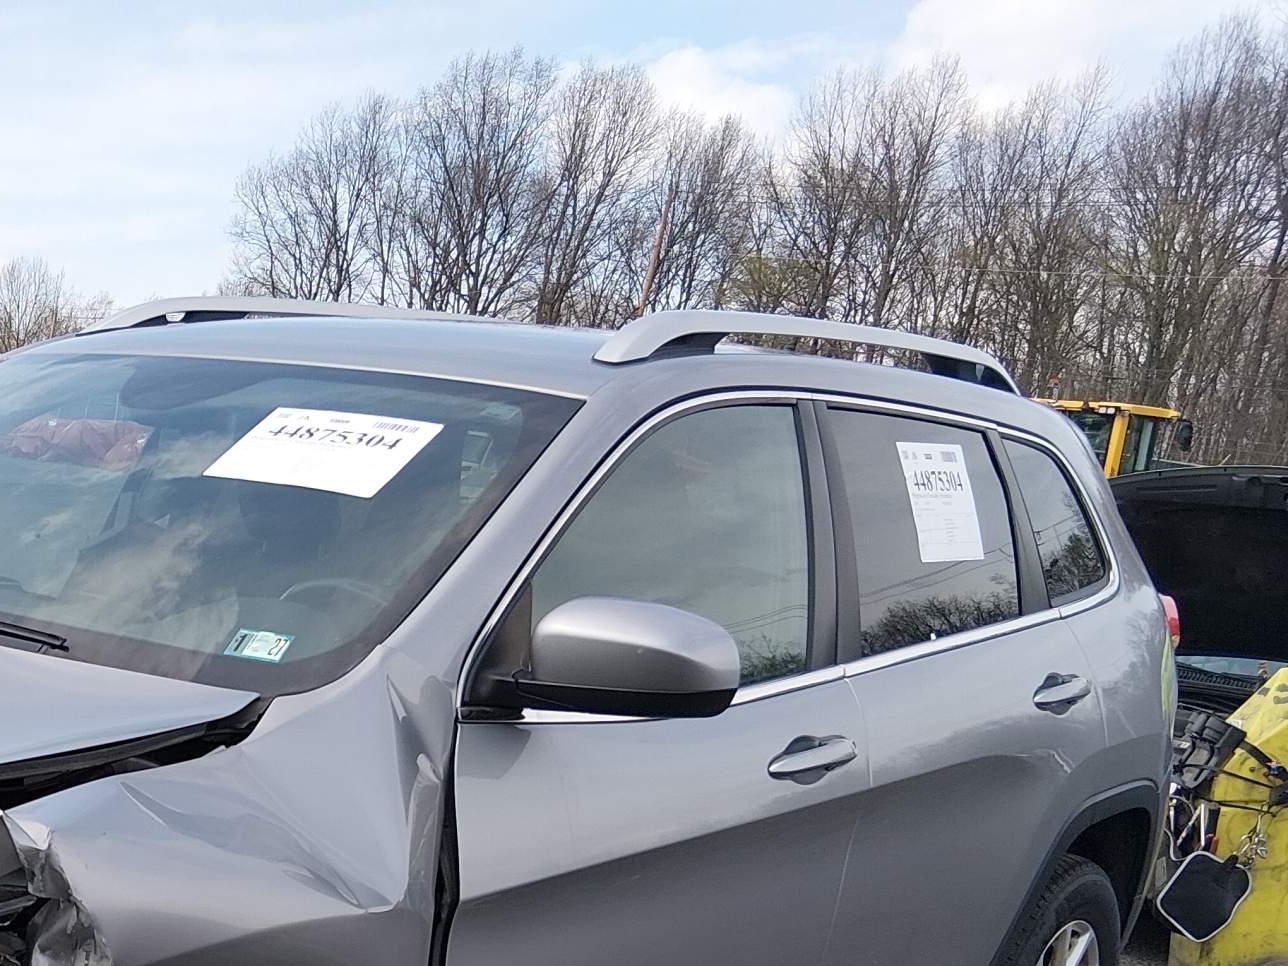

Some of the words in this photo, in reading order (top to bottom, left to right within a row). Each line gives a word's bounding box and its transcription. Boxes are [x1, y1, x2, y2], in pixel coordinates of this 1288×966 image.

[268, 424, 403, 450] 44875304
[913, 469, 963, 492] 44875304
[268, 638, 289, 656] 27
